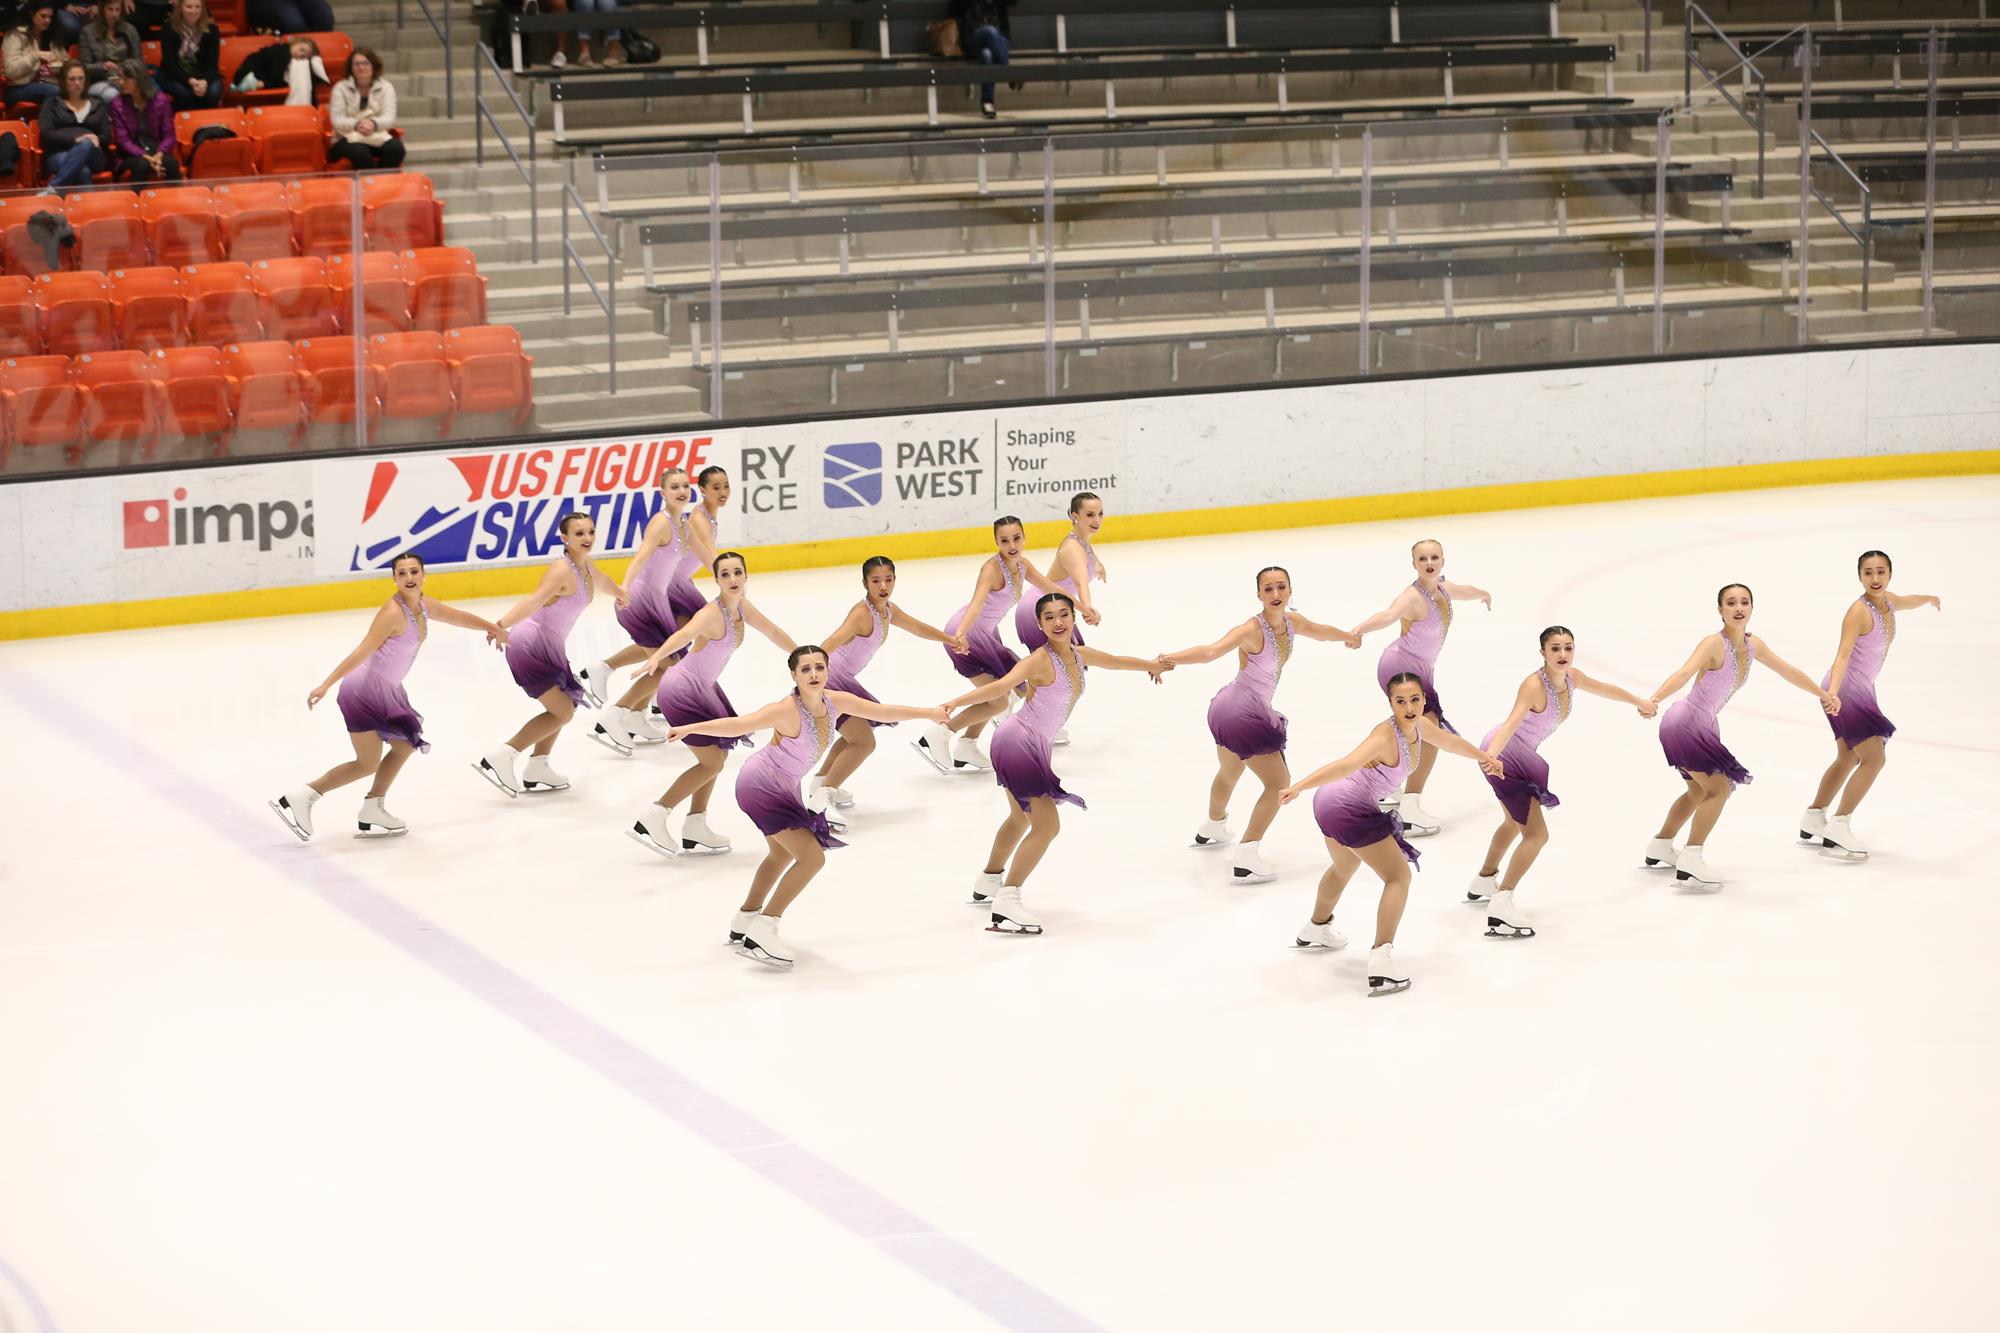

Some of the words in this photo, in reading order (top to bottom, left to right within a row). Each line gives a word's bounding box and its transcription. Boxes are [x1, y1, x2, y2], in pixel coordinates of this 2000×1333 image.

[1007, 428, 1075, 447] Shaping
[491, 449, 553, 499] US
[553, 437, 712, 496] FIGURE
[741, 444, 796, 481] RY
[896, 438, 980, 469] PARK
[1007, 456, 1048, 471] Your
[895, 469, 983, 500] WEST
[1006, 473, 1117, 495] Environment
